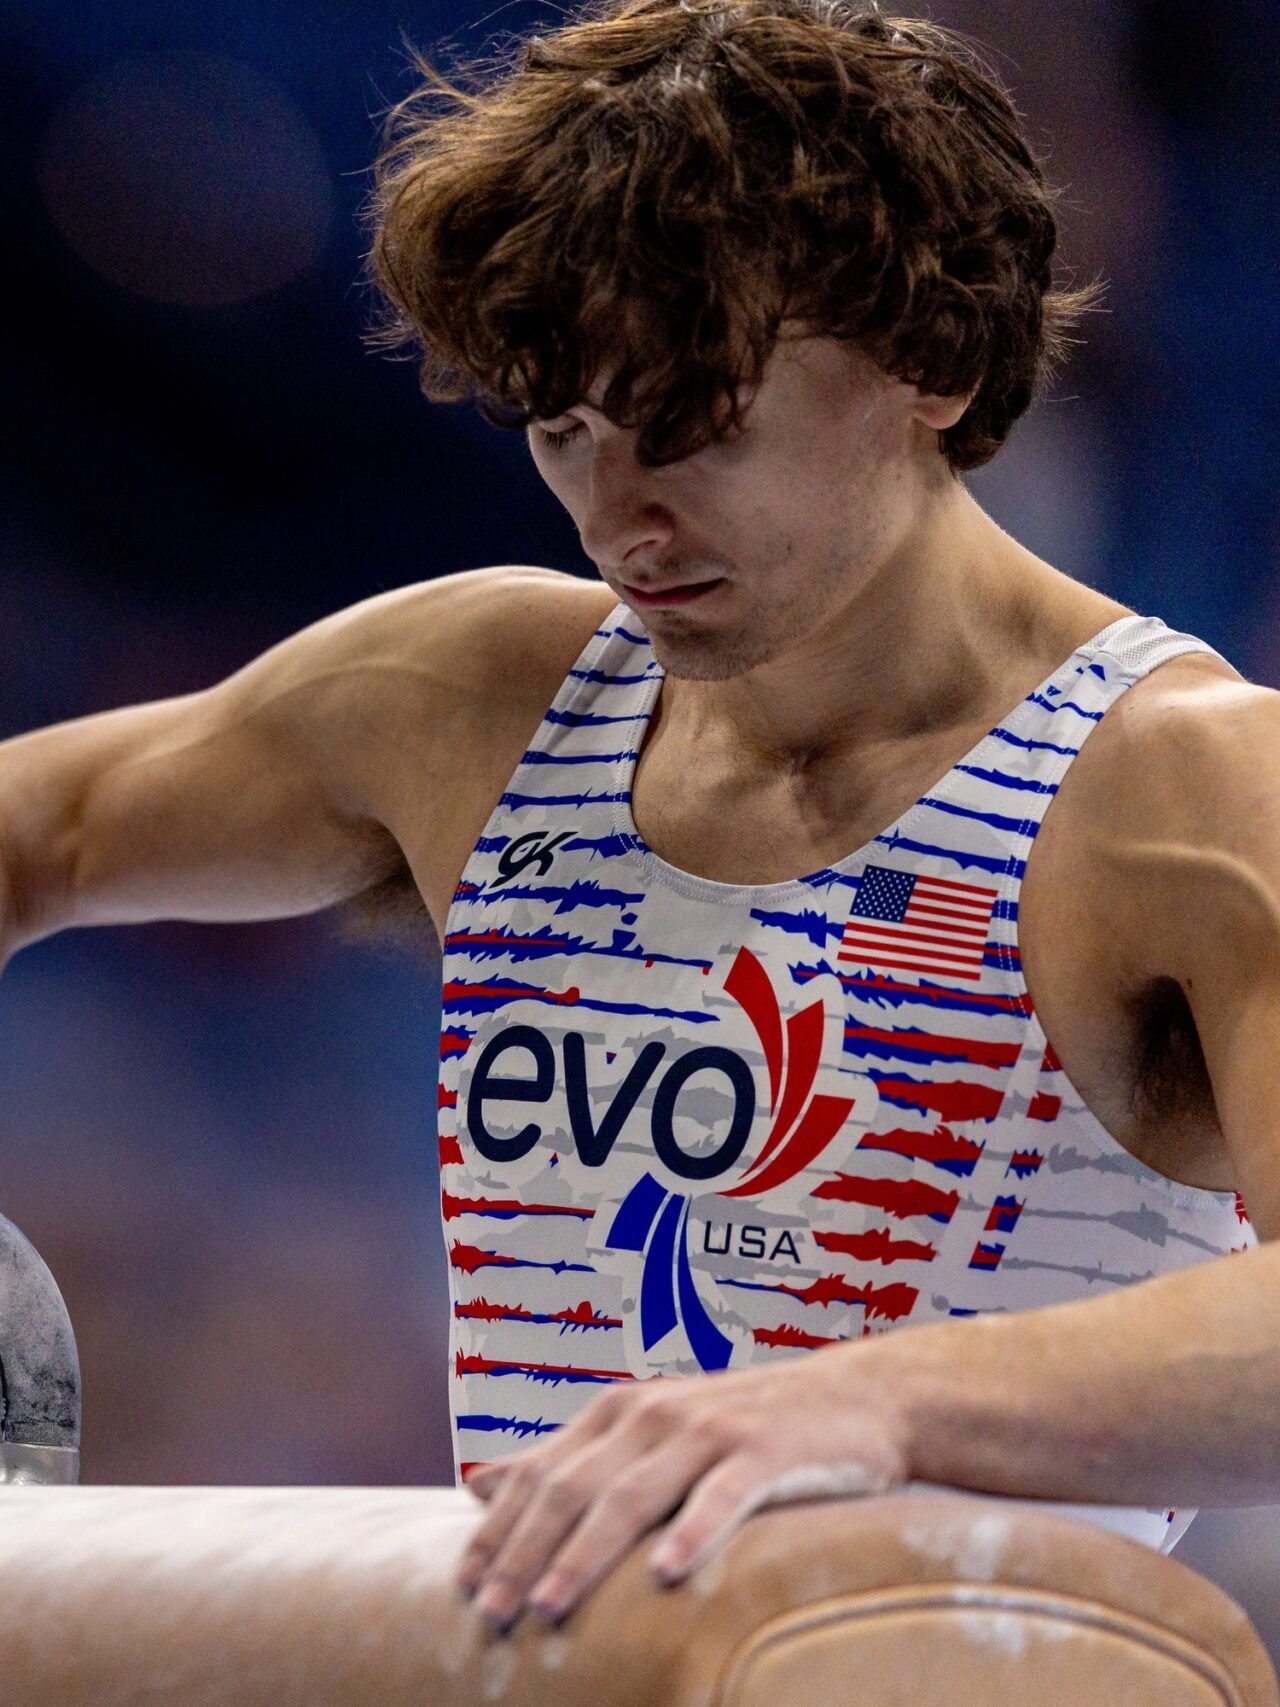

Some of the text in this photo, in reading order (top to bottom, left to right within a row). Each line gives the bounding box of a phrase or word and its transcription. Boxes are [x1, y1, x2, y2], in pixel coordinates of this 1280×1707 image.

[488, 831, 579, 889] GK
[467, 1025, 756, 1180] evo
[703, 1220, 801, 1265] USA
